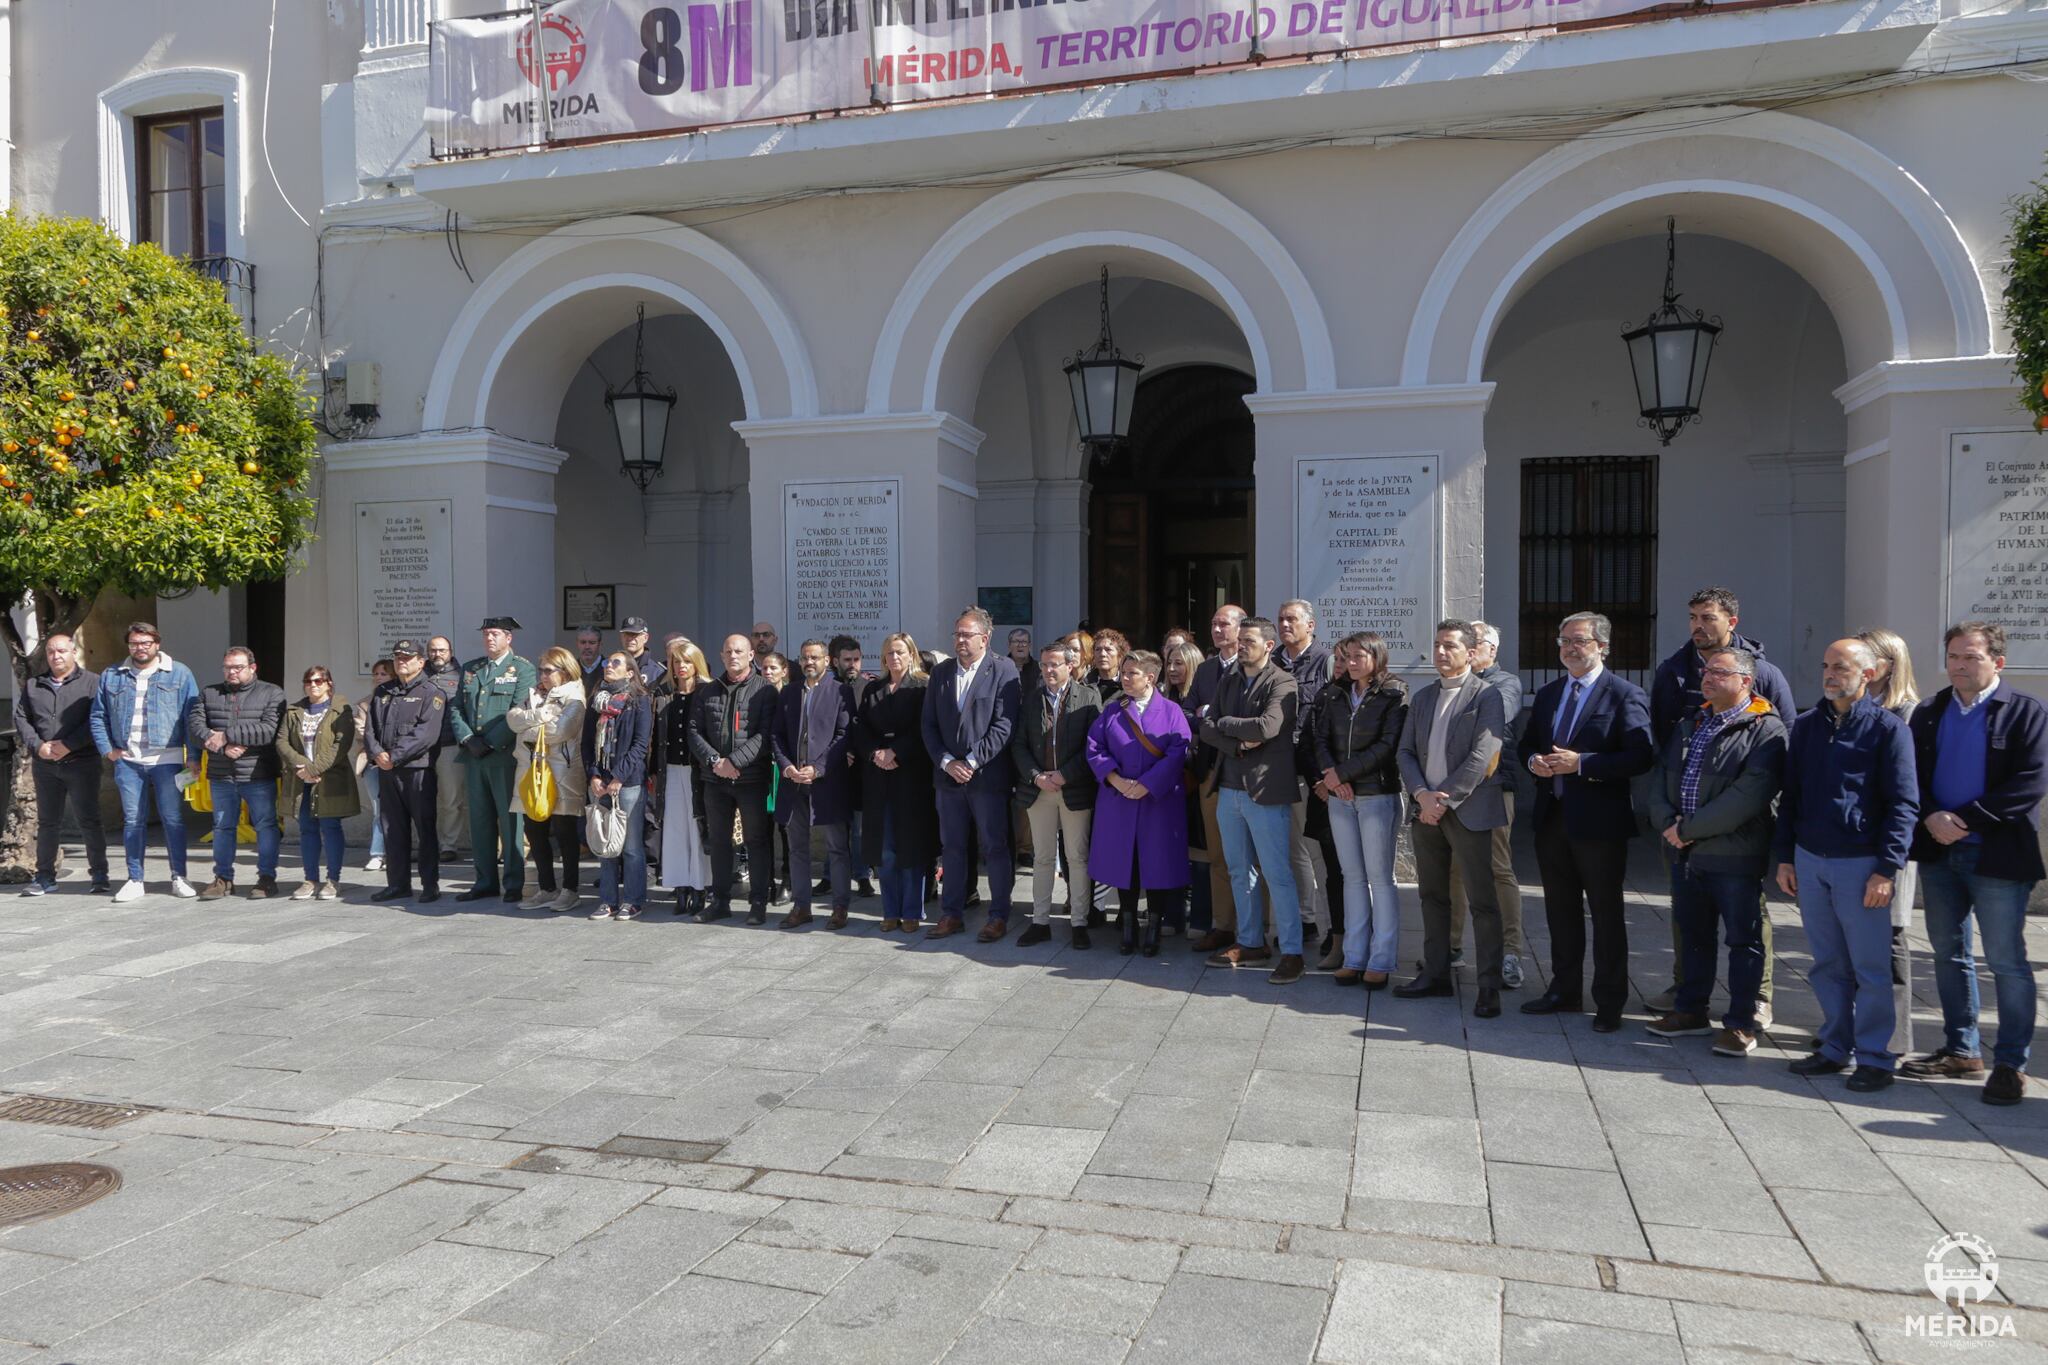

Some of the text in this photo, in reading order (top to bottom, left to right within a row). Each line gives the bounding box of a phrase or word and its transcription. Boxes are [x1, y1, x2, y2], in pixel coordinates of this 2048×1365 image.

[638, 0, 752, 97] 8M
[863, 43, 1023, 89] MÉRIDA,
[1036, 8, 1276, 69] TERRITORIO
[1288, 0, 1344, 37] DE
[1986, 462, 1995, 471] El
[1322, 478, 1332, 486] La
[1336, 478, 1354, 486] sede
[1358, 477, 1368, 485] de
[1382, 476, 1412, 486] JVNTA
[1988, 475, 1998, 484] de
[1357, 487, 1410, 496] ASAMBLEA
[2004, 487, 2048, 499] por la VN
[843, 497, 855, 506] DE
[858, 496, 887, 505] MERIDA
[1360, 499, 1374, 508] fija
[1366, 512, 1381, 520] que
[1398, 509, 1406, 517] la
[840, 528, 850, 536] SE
[1336, 528, 1398, 537] CAPITAL DE
[2018, 525, 2036, 535] DE
[796, 539, 812, 547] ESTA
[816, 538, 842, 546] GVERRA
[873, 537, 888, 545] LOS
[1329, 539, 1406, 548] EXTREMADVRA
[796, 549, 840, 558] CANTABROS
[797, 560, 828, 568] AVGVSTO
[830, 560, 864, 568] LICENCIO
[874, 558, 888, 566] LOS
[1992, 563, 1999, 572] el
[2027, 562, 2037, 572] de
[797, 570, 837, 578] SOLDADOS
[796, 580, 888, 589] ORDENO QVE FVNDARAN
[1984, 576, 1994, 586] de
[2034, 576, 2042, 585] el
[798, 592, 808, 600] EN
[872, 590, 888, 598] VNA
[1986, 590, 1997, 600] de
[2000, 590, 2008, 600] la
[2012, 590, 2032, 600] XVII
[1318, 598, 1336, 606] LEY
[1340, 596, 1389, 606] ORGÁNICA
[1351, 609, 1364, 617] DE
[1368, 608, 1412, 617] FEBRERO
[2004, 604, 2014, 613] de
[1328, 620, 1400, 628] DEL ESTATVTO
